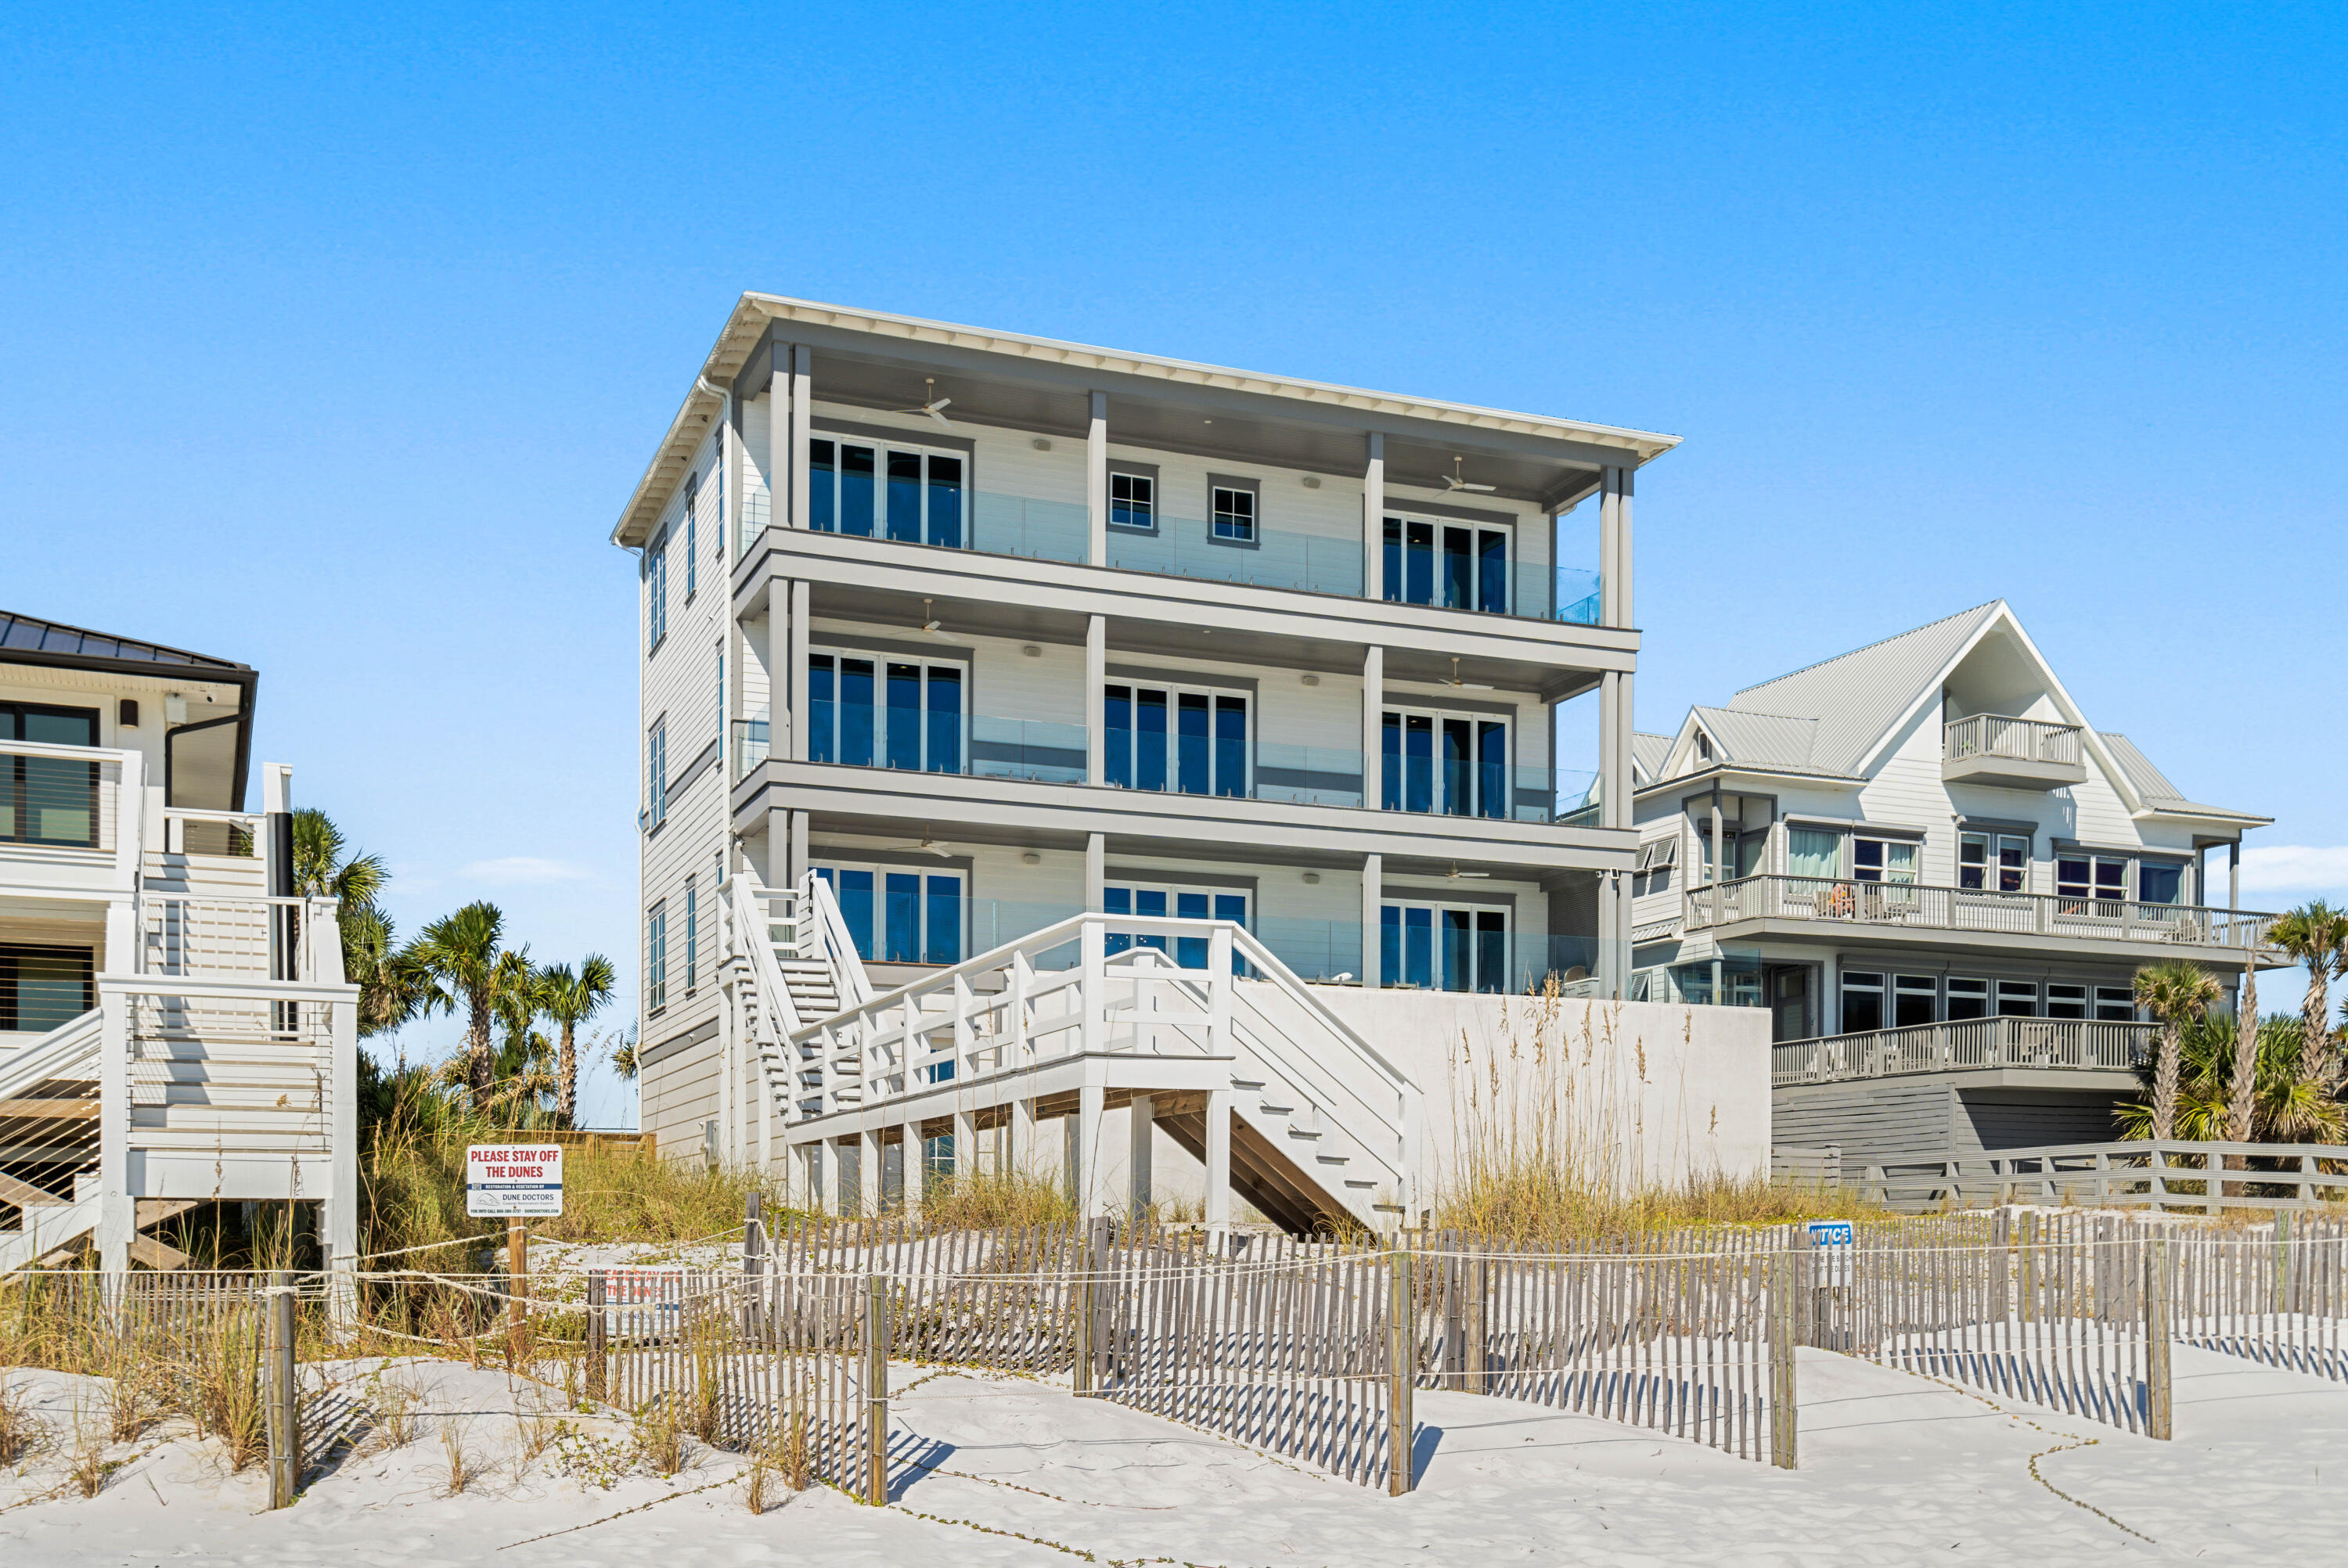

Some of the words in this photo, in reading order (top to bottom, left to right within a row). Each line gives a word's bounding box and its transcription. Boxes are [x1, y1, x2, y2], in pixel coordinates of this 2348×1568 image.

[471, 1151, 510, 1162] PLEASE
[512, 1151, 537, 1162] STAY
[540, 1151, 558, 1162] OFF
[486, 1166, 505, 1178] THE
[508, 1166, 543, 1178] DUNES
